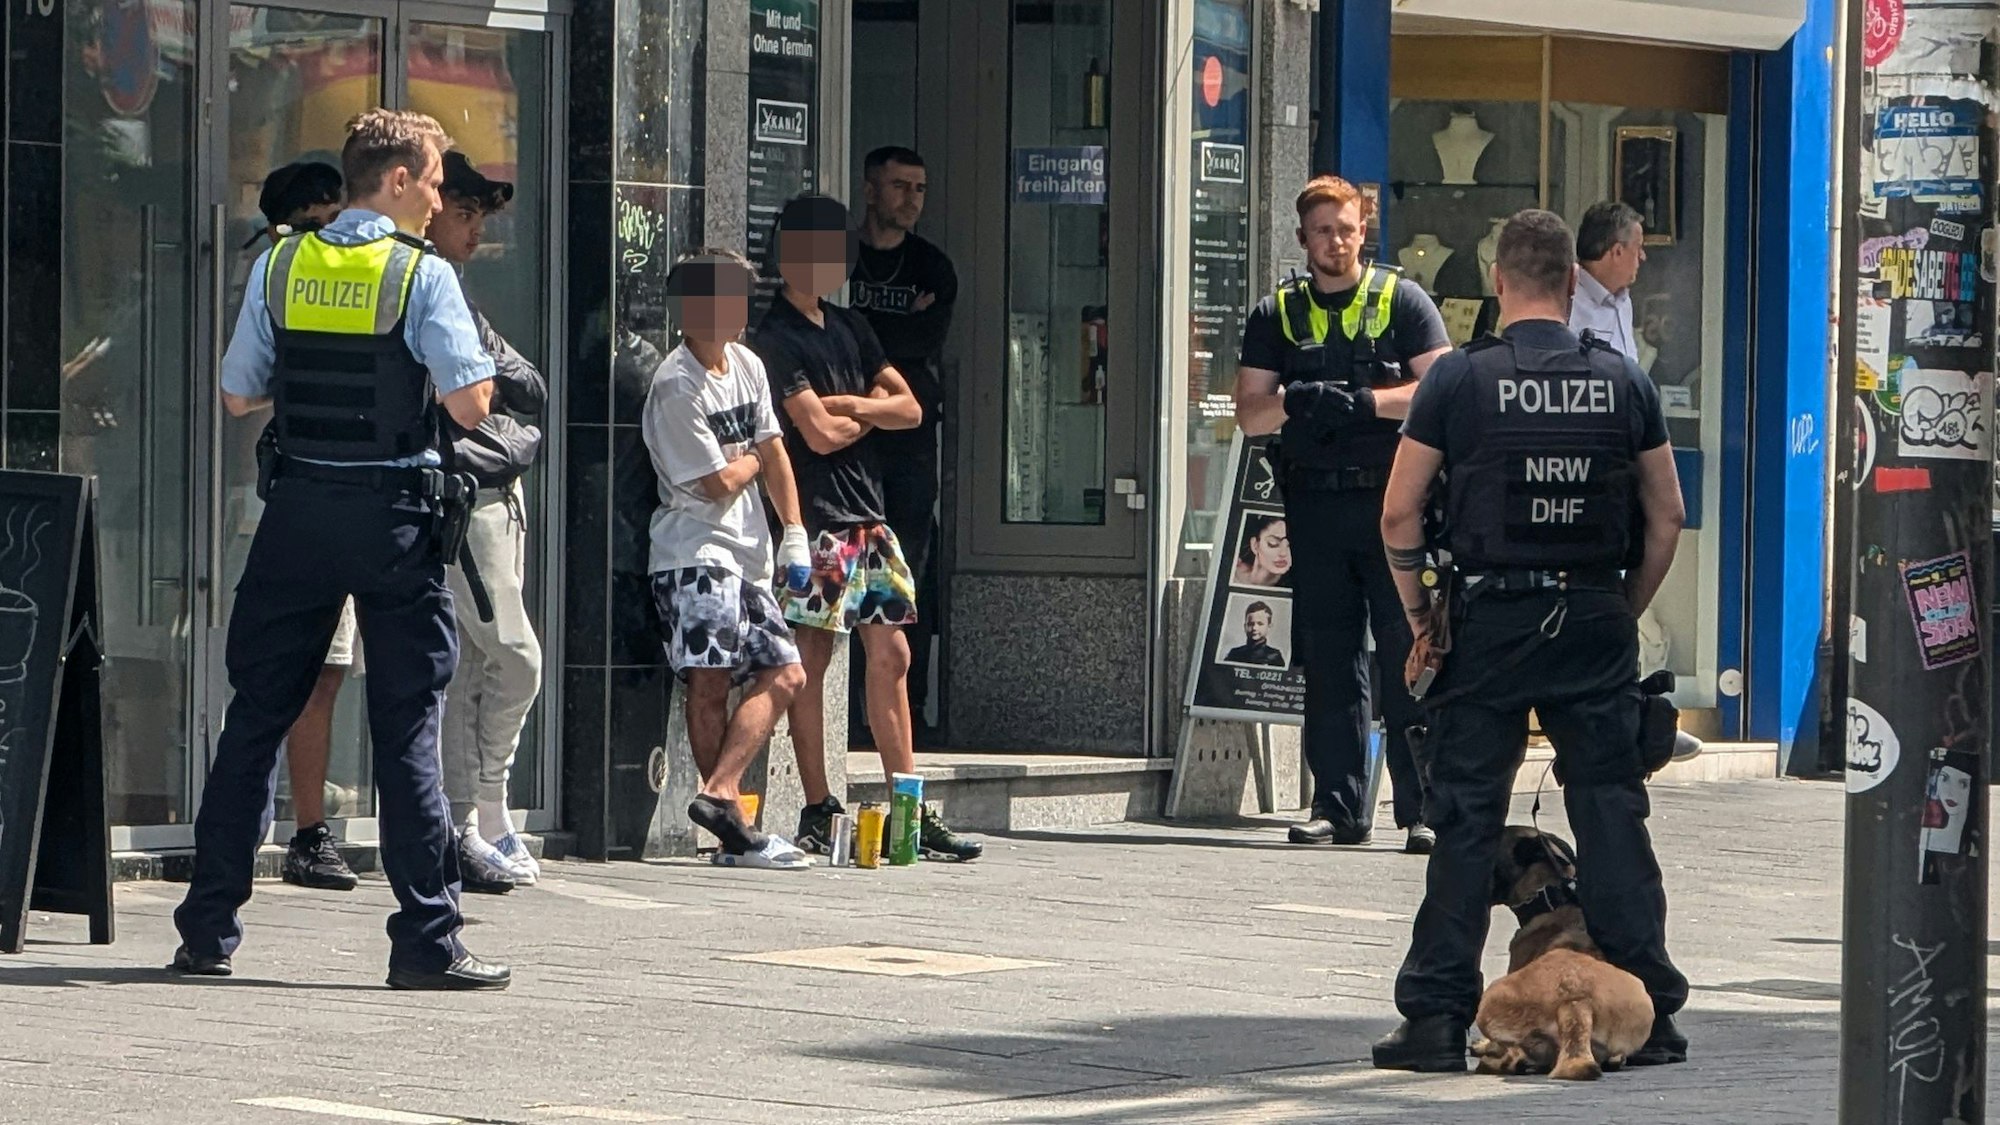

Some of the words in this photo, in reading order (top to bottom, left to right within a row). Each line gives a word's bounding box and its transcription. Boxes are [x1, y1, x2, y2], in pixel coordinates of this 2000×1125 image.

[765, 9, 781, 28] Mit
[783, 13, 801, 31] und
[753, 34, 779, 54] Ohne
[781, 36, 813, 57] Termin
[1894, 112, 1955, 128] HELLO
[1028, 154, 1104, 176] Eingang
[1018, 175, 1107, 193] freihalten
[292, 277, 373, 309] POLIZEI
[1498, 379, 1615, 413] POLIZEI
[1525, 457, 1592, 482] NRW
[1531, 498, 1585, 524] DHF
